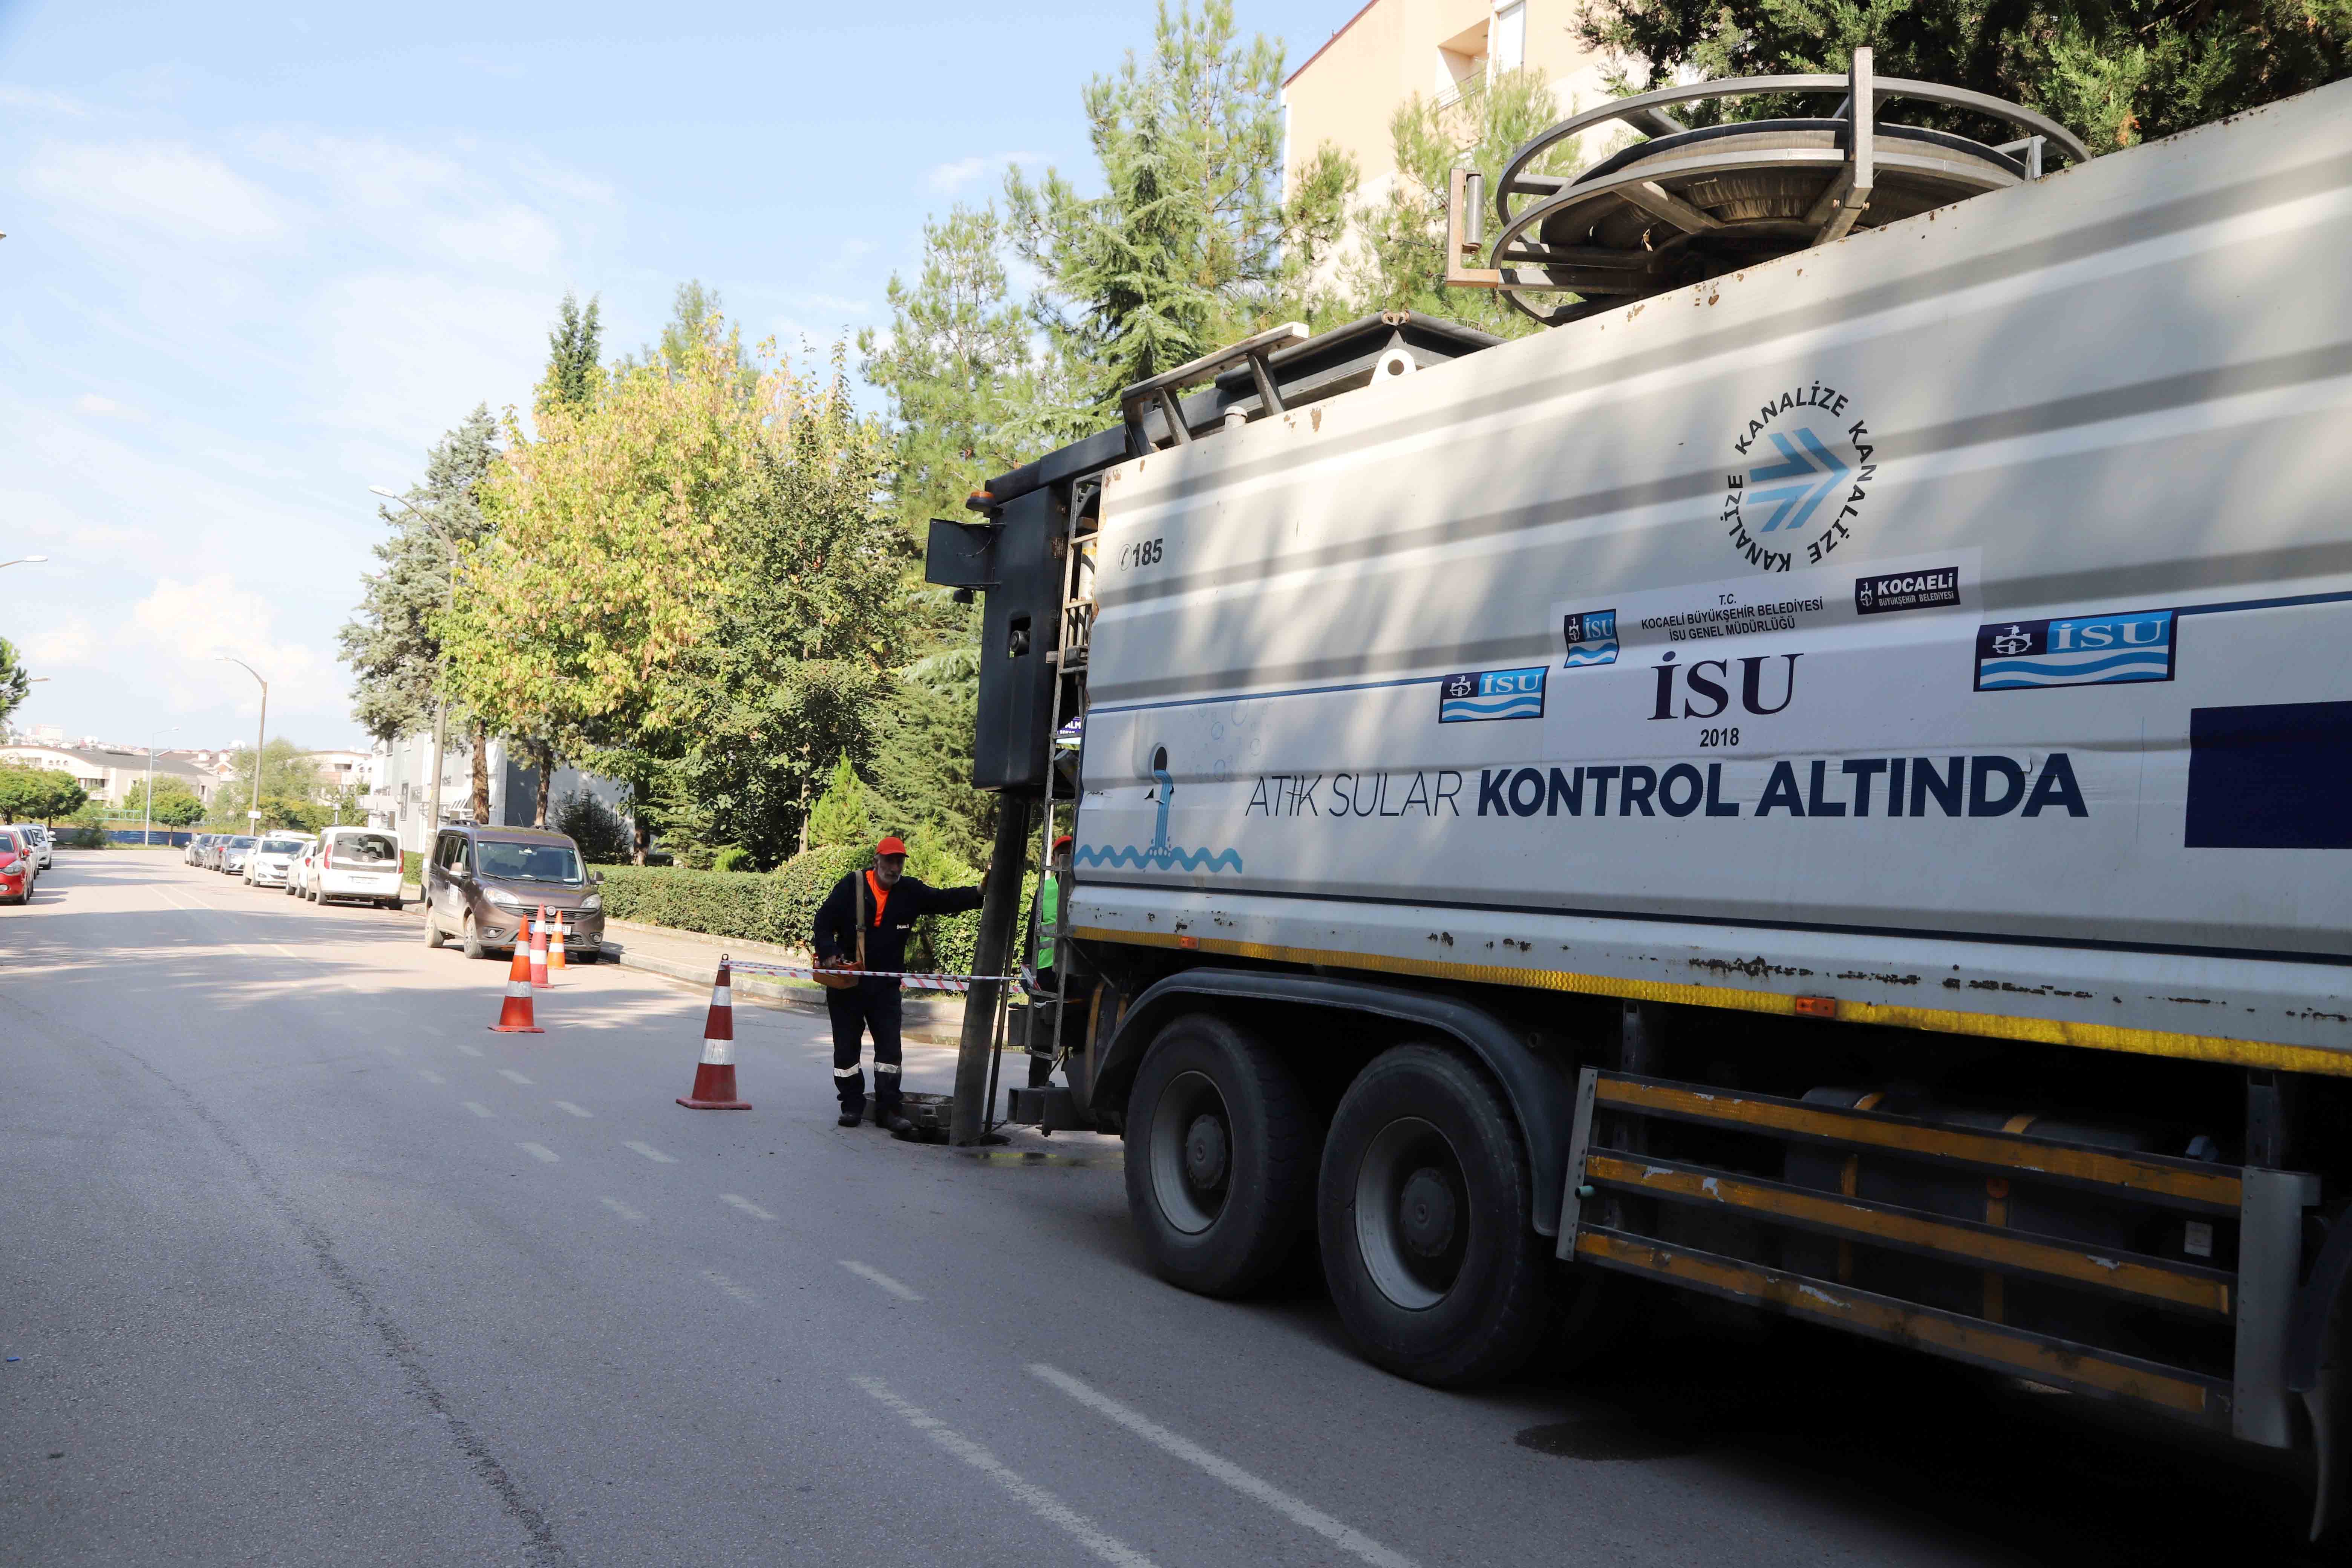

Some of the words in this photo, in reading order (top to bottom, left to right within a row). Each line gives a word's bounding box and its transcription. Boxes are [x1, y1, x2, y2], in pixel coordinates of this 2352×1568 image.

[1735, 380, 1849, 455] KANALİZE
[1807, 420, 1877, 564] KANALİZE
[1133, 538, 1163, 567] 185
[1641, 612, 1685, 629] KOCAELİ
[1687, 605, 1755, 624] BÜYÜKŞEHİR
[1758, 596, 1823, 616] BELEDİYESİ
[1719, 594, 1736, 605] T.C.
[1669, 629, 1686, 641] İSU
[1689, 626, 1724, 639] GENEL
[1726, 616, 1795, 635] MÜDÜRLÜĞÜ
[1647, 651, 1804, 720] İSU
[1700, 728, 1739, 747] 2018
[1245, 774, 1322, 816] ATIK
[1329, 771, 1462, 817] SULAR
[1478, 763, 1740, 817] KONTROL
[1754, 753, 2089, 817] ALTINDA
